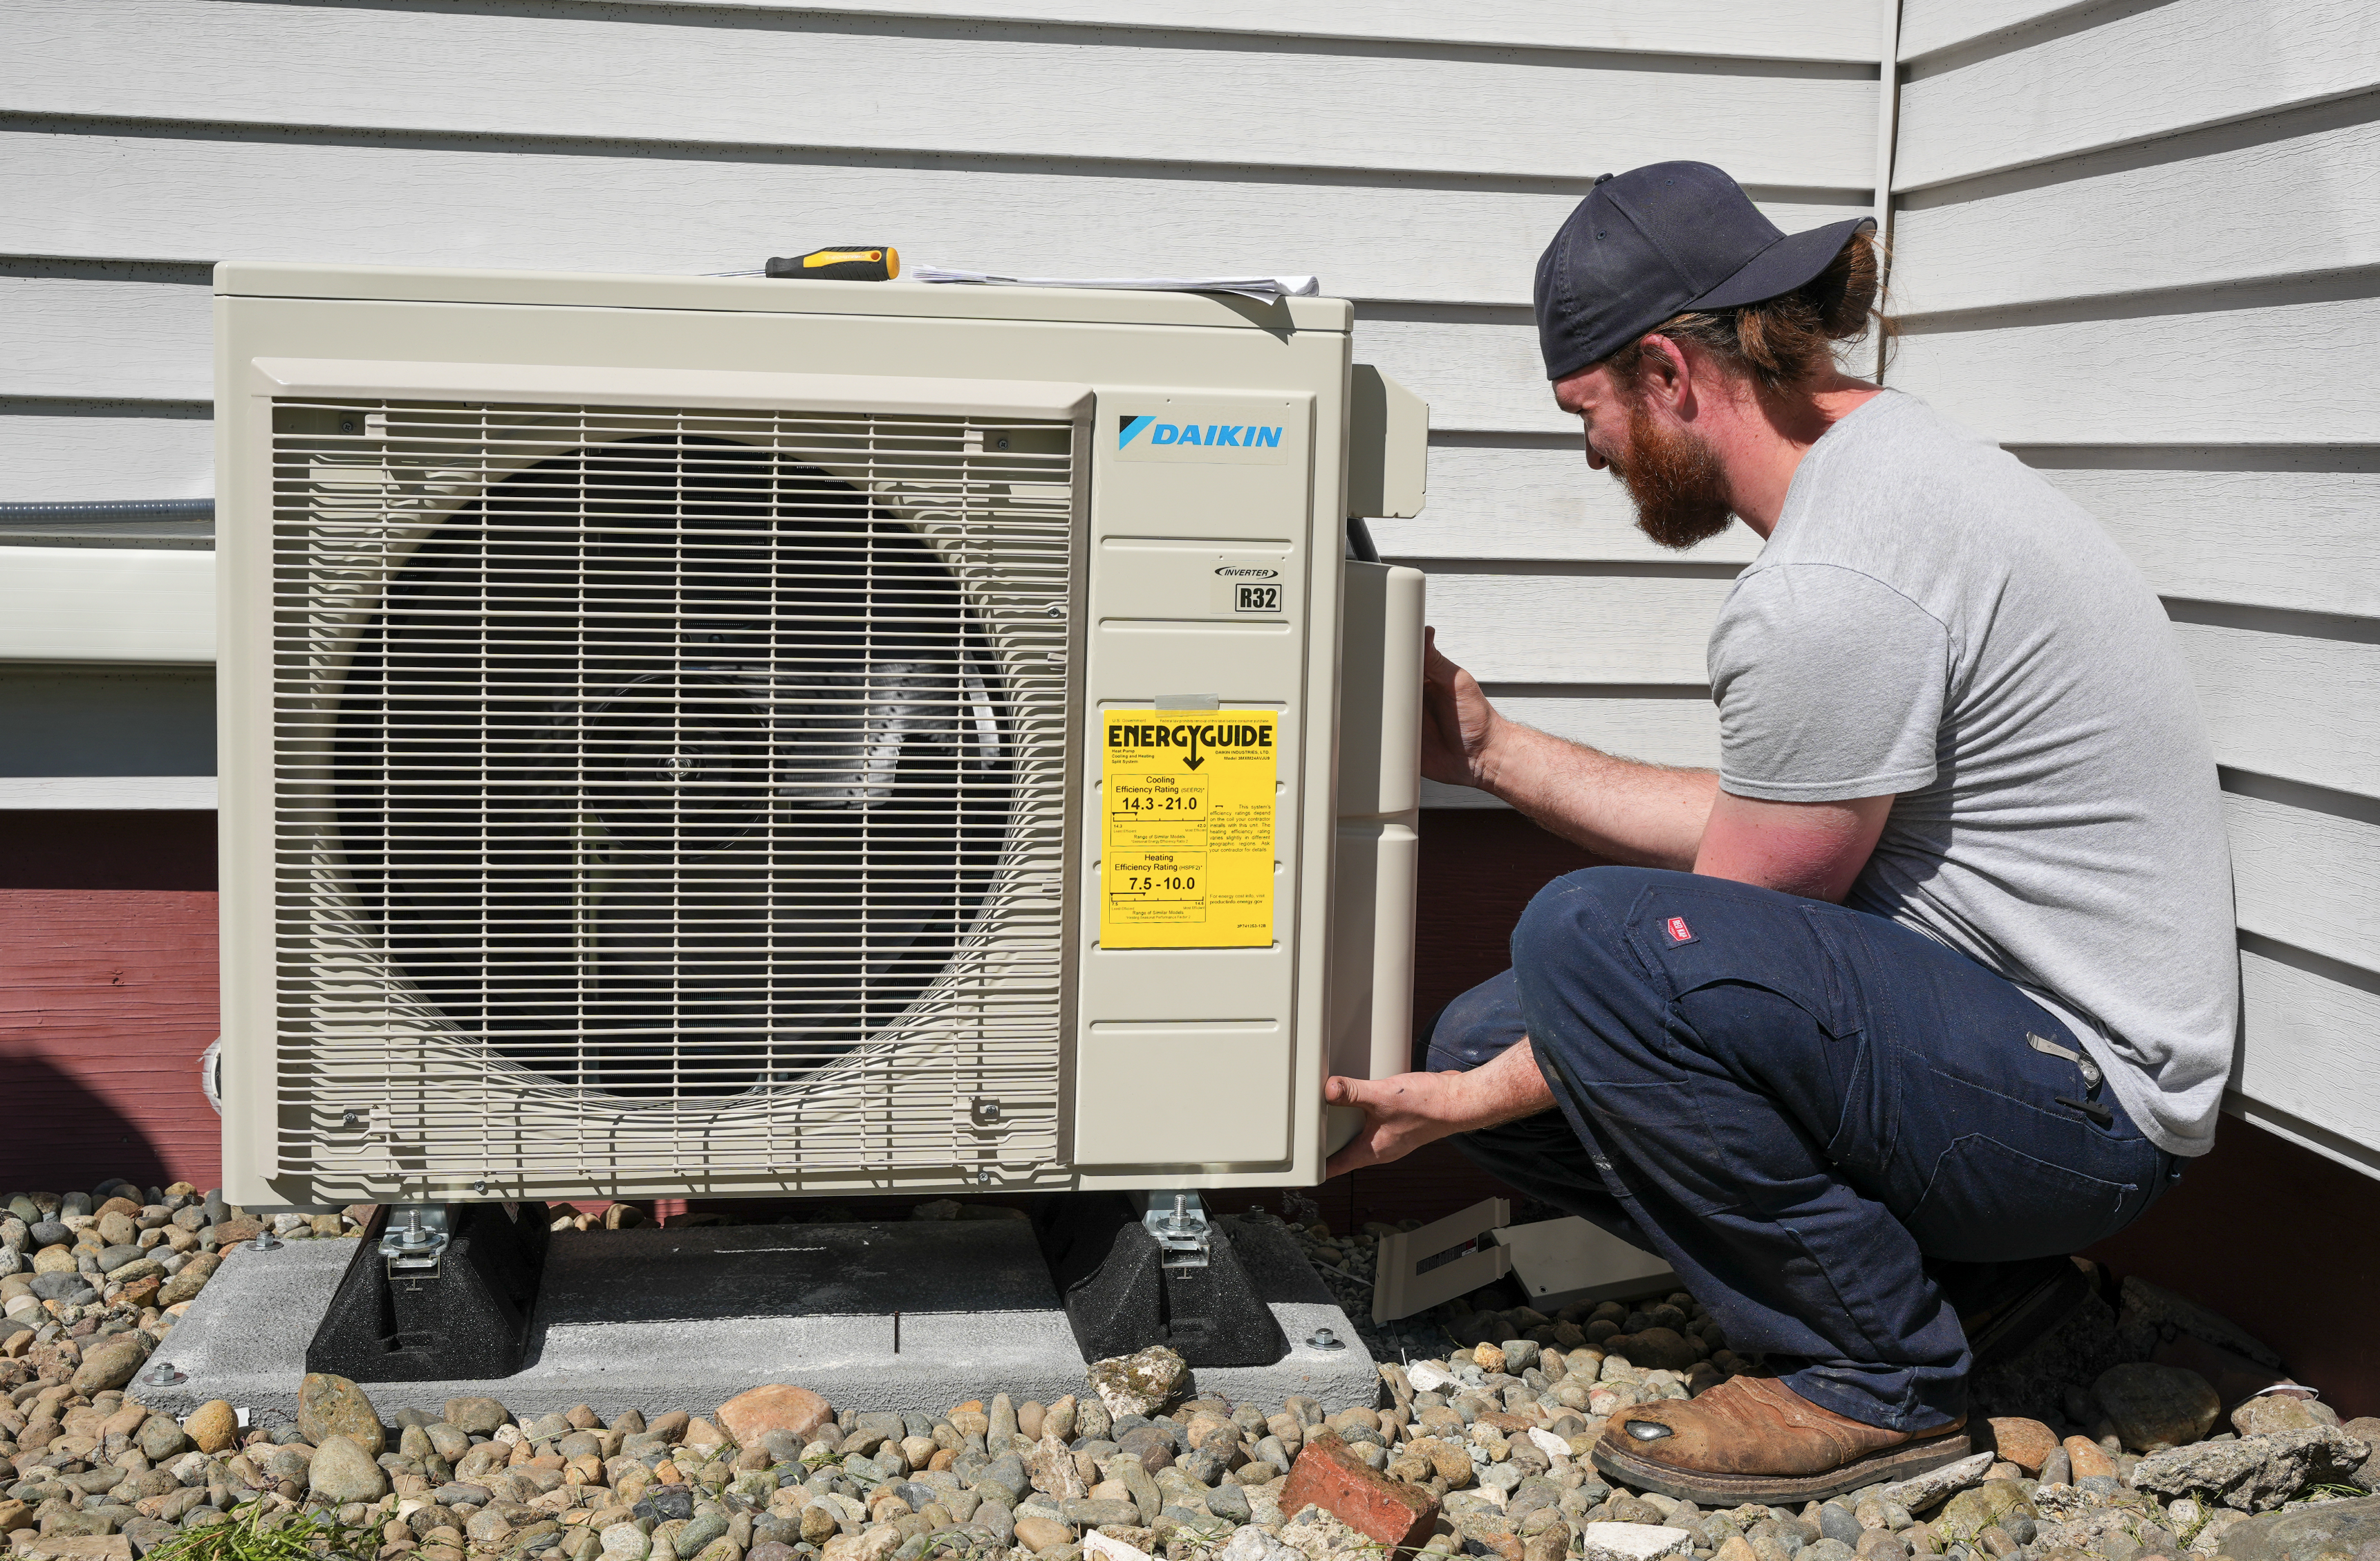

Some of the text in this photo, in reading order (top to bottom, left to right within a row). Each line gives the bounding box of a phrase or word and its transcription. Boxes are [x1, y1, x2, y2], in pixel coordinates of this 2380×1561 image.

[1151, 424, 1283, 447] DAIKIN
[1240, 588, 1276, 608] R32
[1108, 725, 1272, 747] ENERGYGUIDE
[1146, 776, 1175, 785] Cooling
[1116, 786, 1153, 794] Efficiency
[1155, 786, 1179, 794] Rating
[1115, 863, 1151, 872] Efficiency
[1153, 863, 1178, 872] Rating
[1673, 920, 1687, 937] RED KAP
